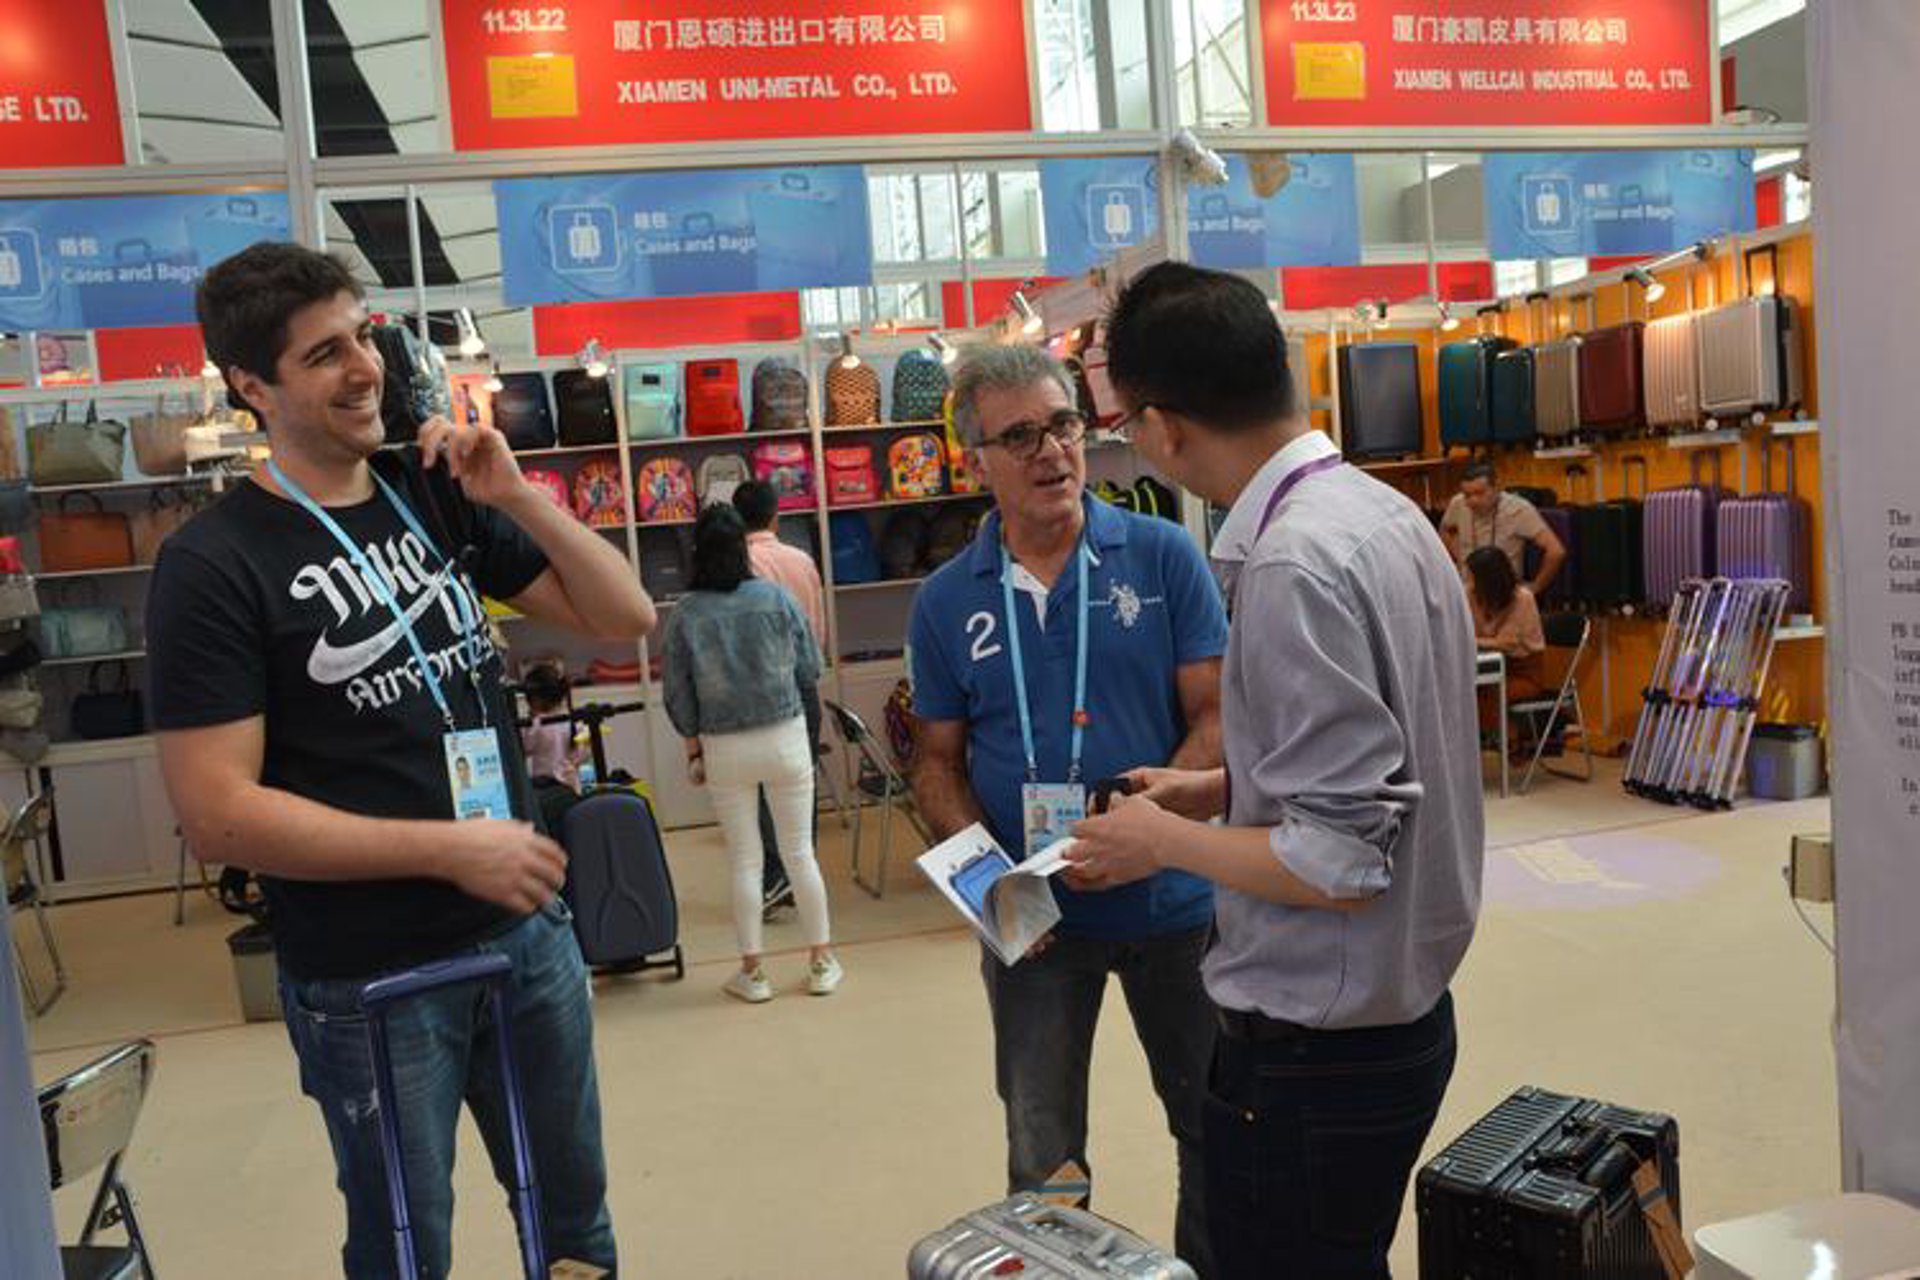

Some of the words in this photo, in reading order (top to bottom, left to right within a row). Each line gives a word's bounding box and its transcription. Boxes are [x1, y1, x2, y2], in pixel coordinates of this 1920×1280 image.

[616, 79, 707, 103] XIAMEN
[719, 75, 840, 101] UNI-METAL
[908, 71, 958, 96] LTD.
[1393, 69, 1452, 89] XIAMEN
[1458, 69, 1525, 90] WELLCAI
[1532, 68, 1619, 90] INDUSTRIAL
[35, 95, 89, 122] LTD.
[634, 237, 681, 255] Cases
[685, 234, 717, 252] and
[719, 232, 758, 255] Bags
[60, 265, 115, 284] Cases
[119, 262, 152, 281] and
[157, 261, 200, 284] Bags
[964, 610, 1002, 662] 2
